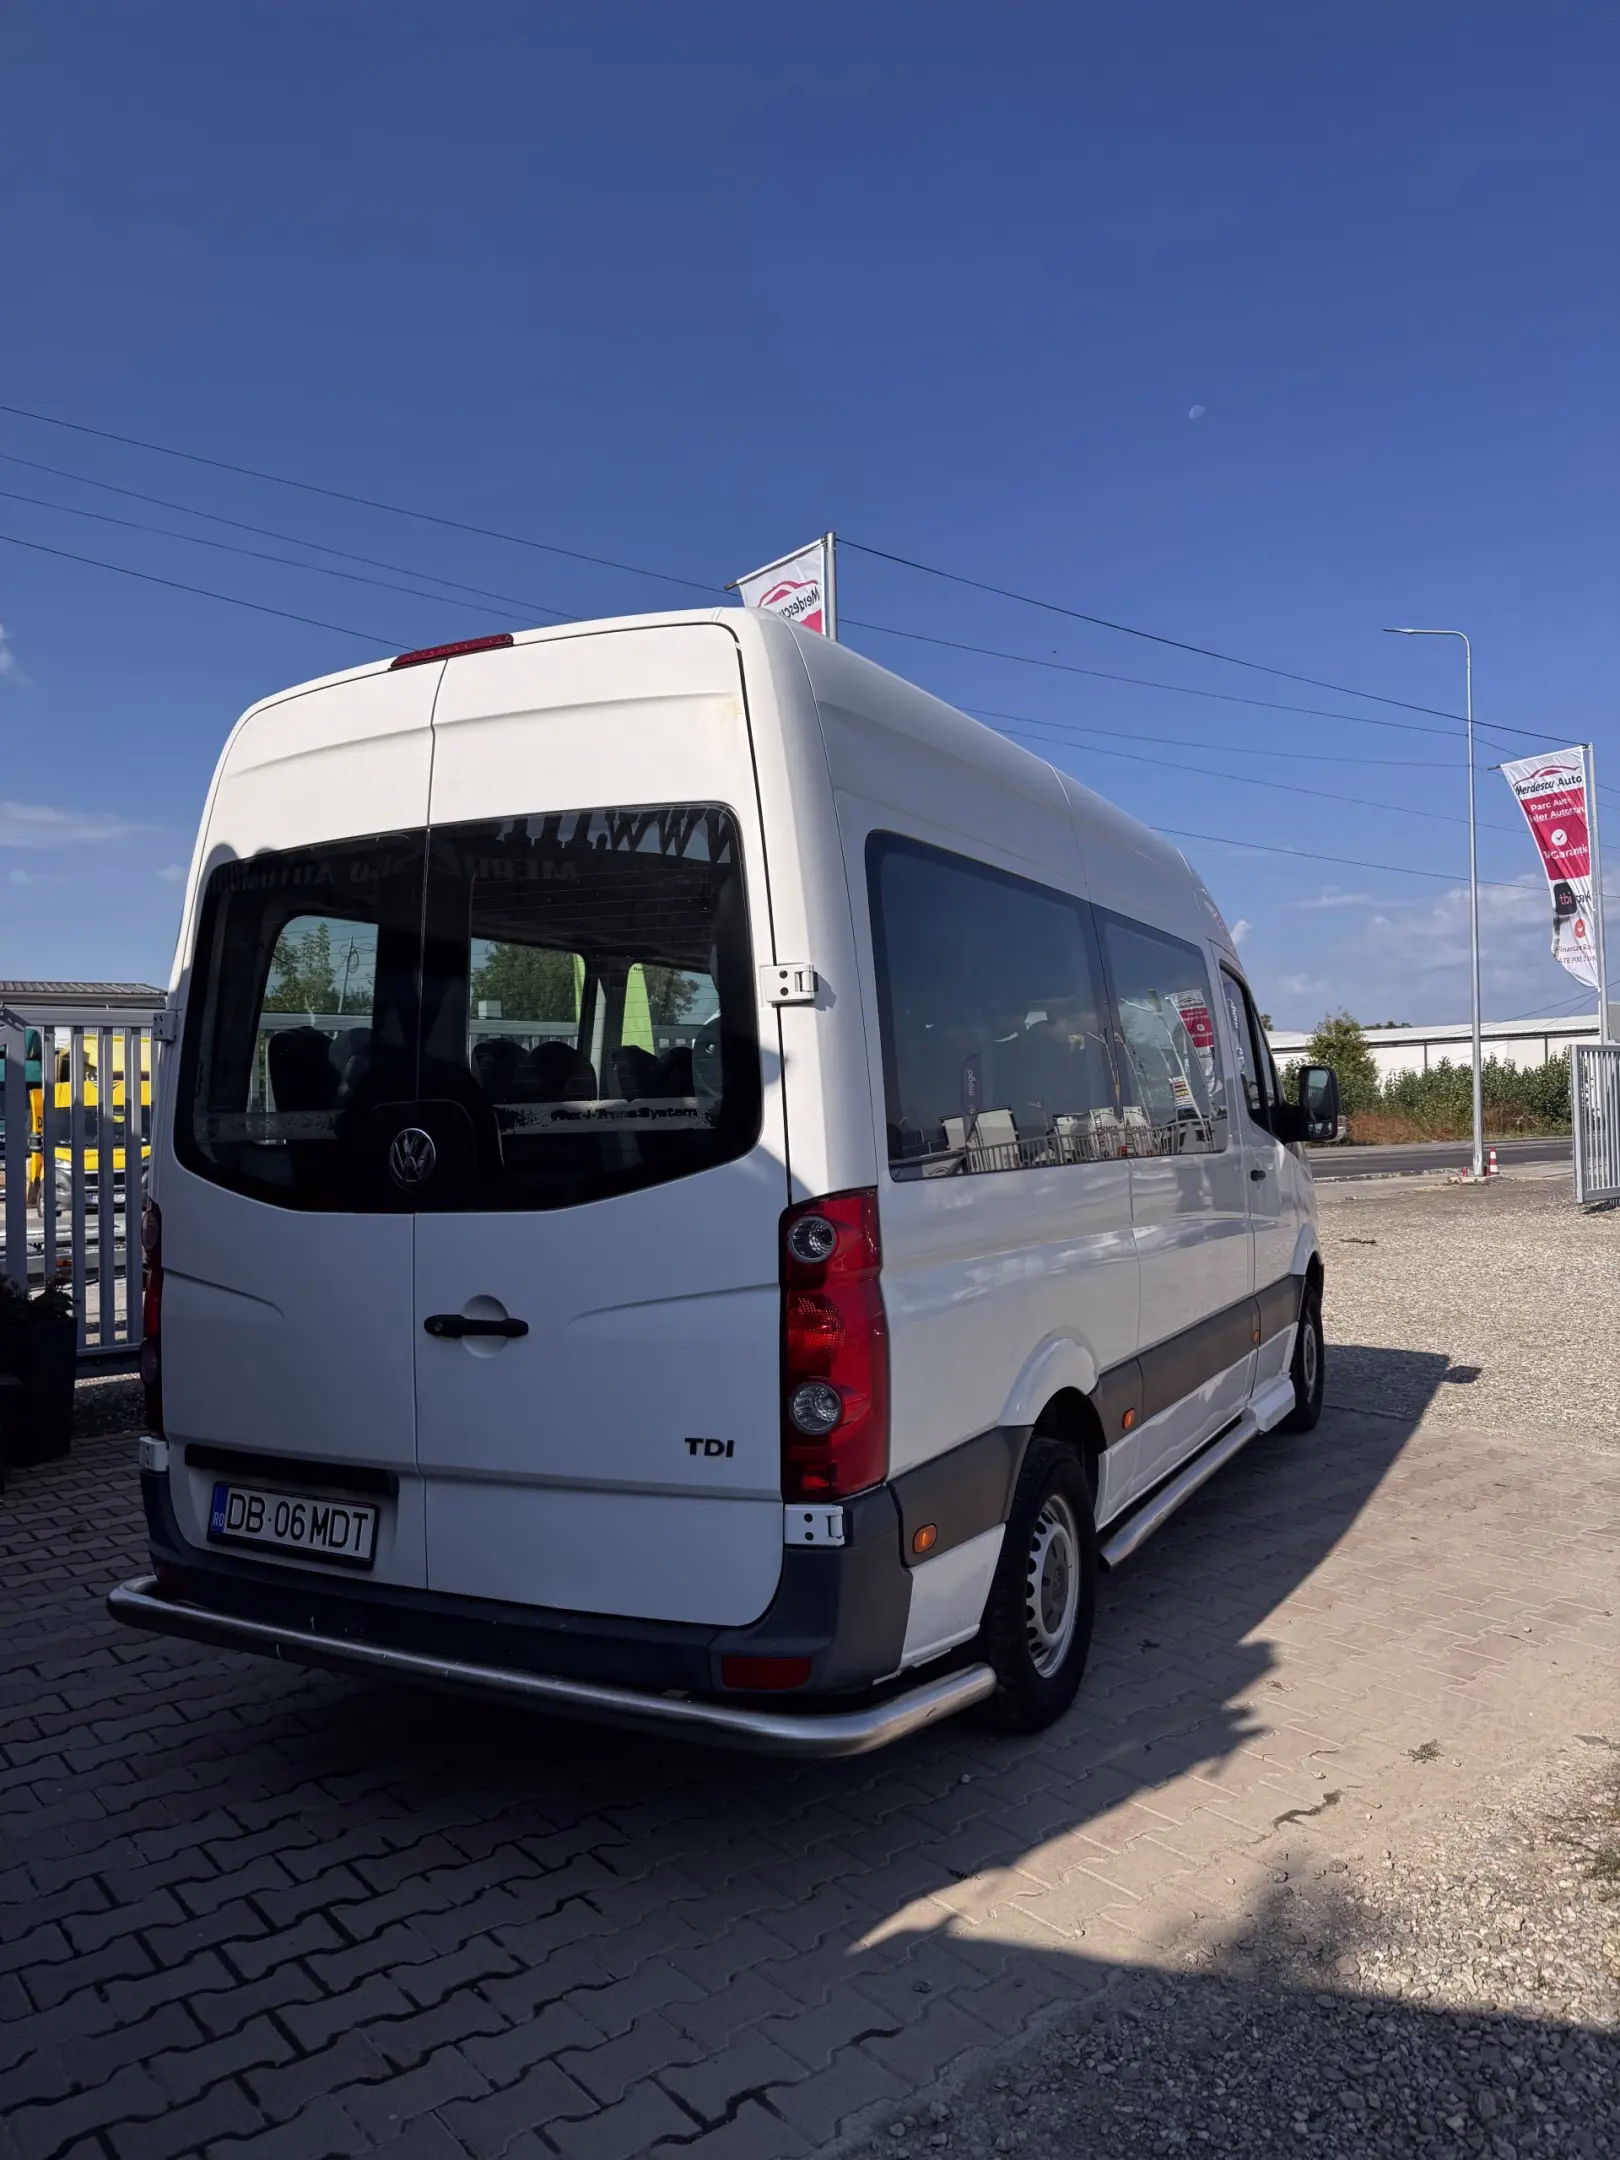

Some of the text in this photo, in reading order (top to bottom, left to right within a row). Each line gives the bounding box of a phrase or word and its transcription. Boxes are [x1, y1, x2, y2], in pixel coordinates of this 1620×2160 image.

[1557, 775, 1583, 787] Auto
[1530, 802, 1552, 812] Parc
[1559, 891, 1573, 905] tbi
[684, 1437, 735, 1458] TDI
[213, 1511, 225, 1527] RO
[226, 1493, 267, 1534] DB
[309, 1506, 370, 1551] MDT
